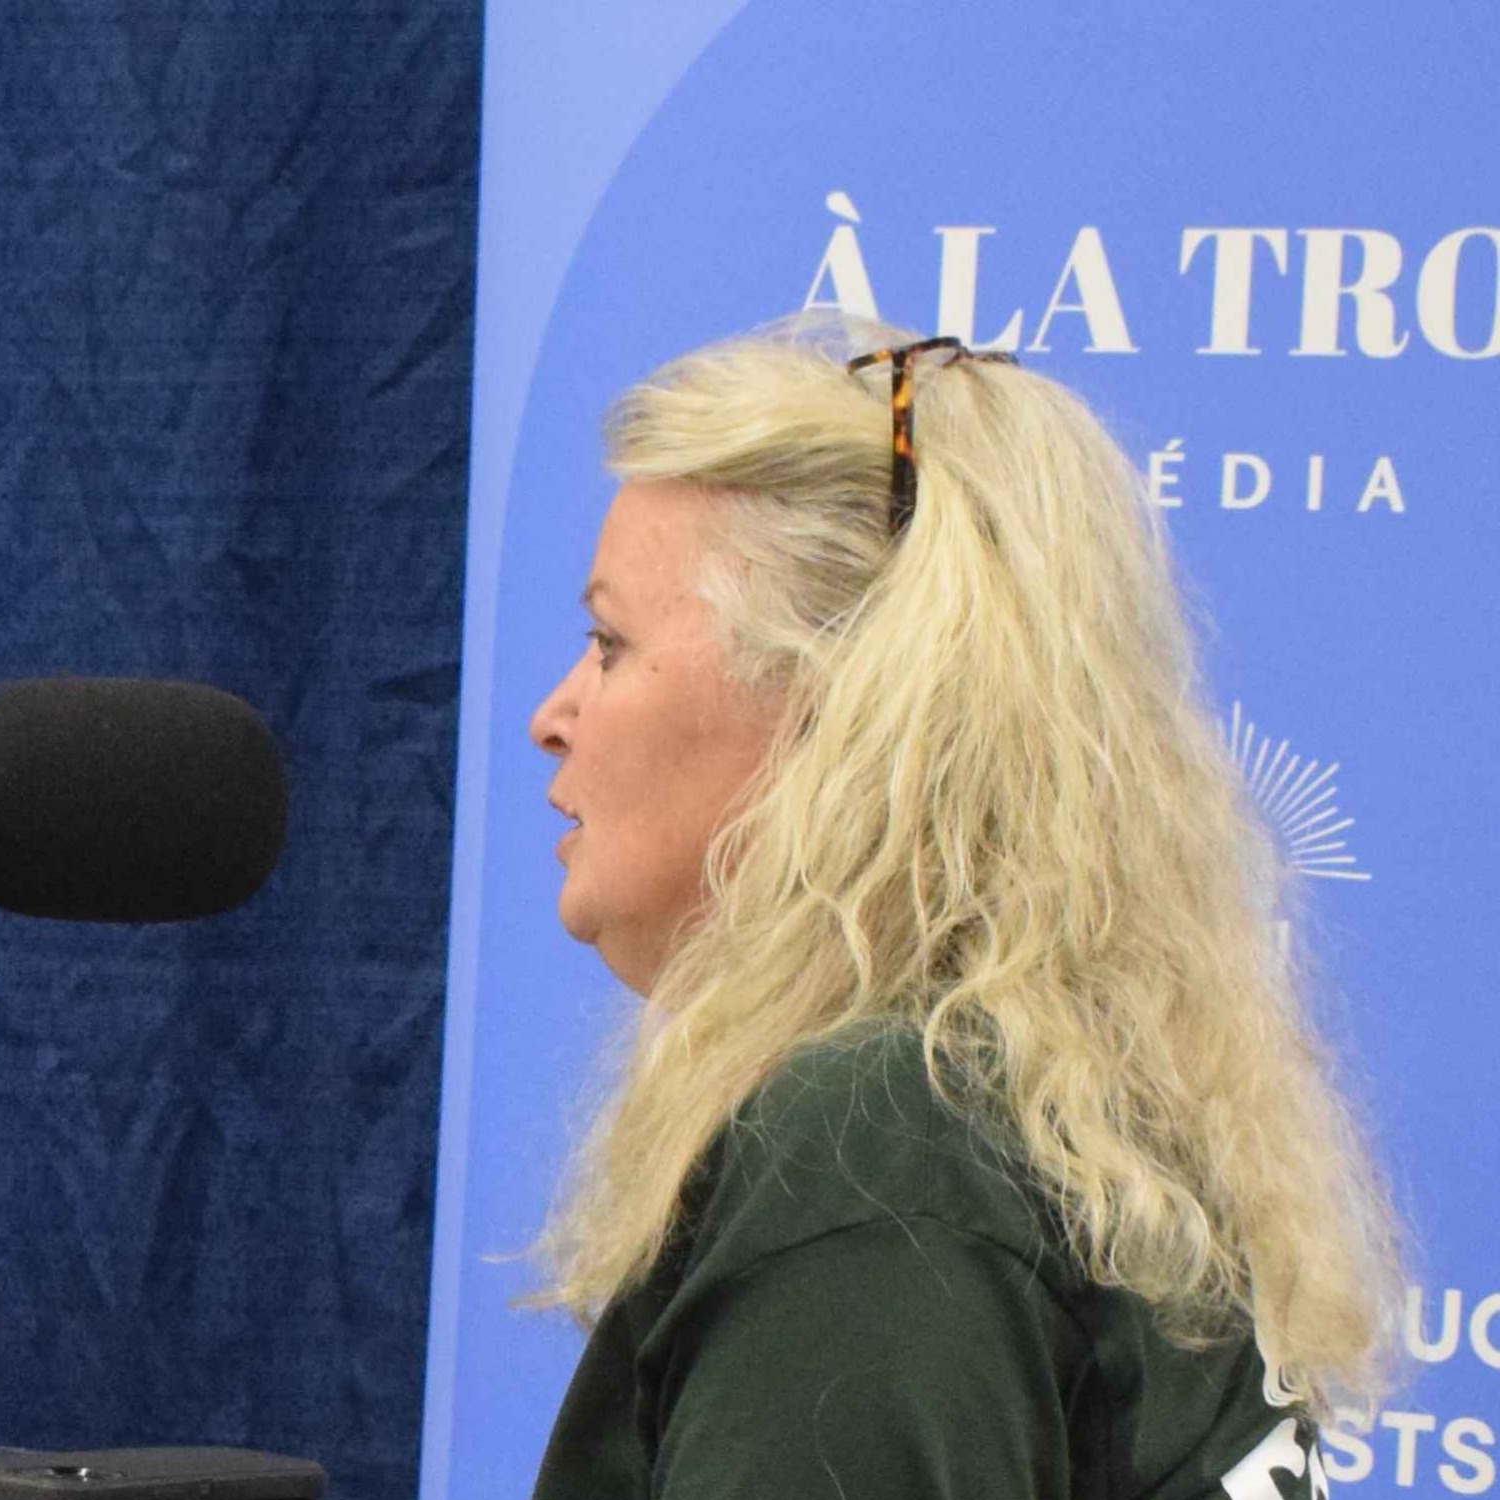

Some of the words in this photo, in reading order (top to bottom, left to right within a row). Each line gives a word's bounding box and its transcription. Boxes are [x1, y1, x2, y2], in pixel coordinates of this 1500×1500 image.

[801, 191, 882, 322] À
[932, 226, 1140, 354] LA
[1149, 438, 1406, 513] ÉDIA
[1321, 1407, 1496, 1495] STS
